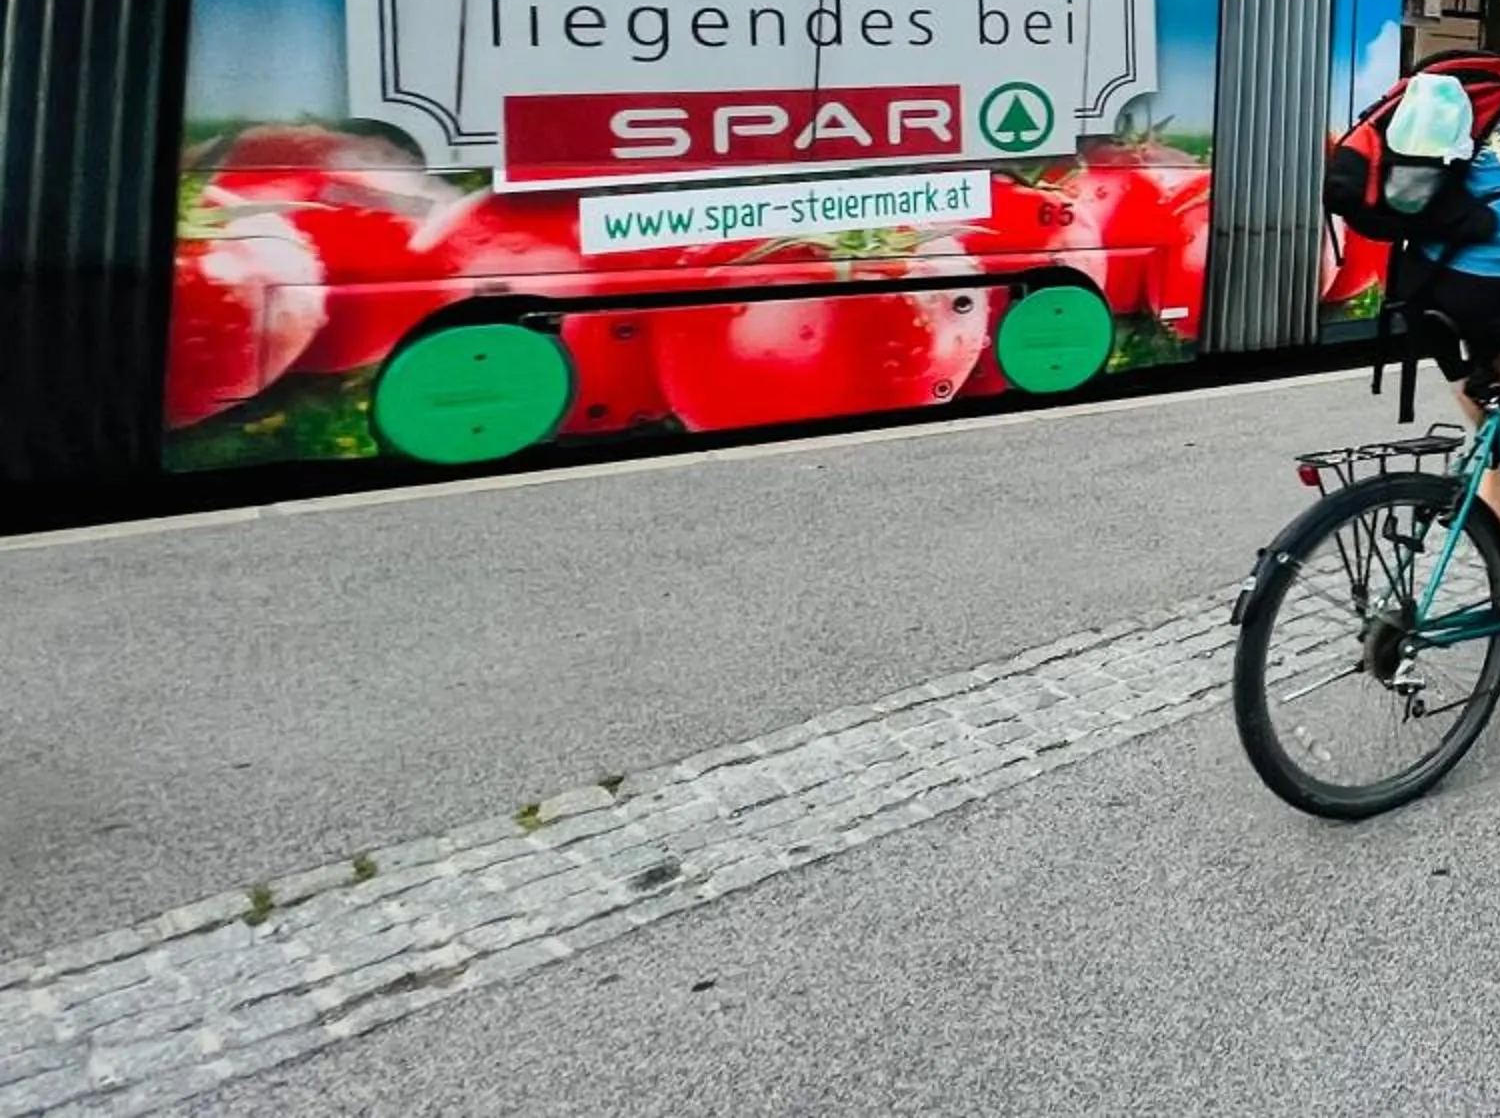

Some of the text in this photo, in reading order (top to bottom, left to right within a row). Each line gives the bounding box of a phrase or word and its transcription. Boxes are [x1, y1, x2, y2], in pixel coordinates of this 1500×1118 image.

[609, 99, 953, 160] SPAR
[603, 179, 972, 240] www.spar-steiermark.at
[1037, 200, 1075, 227] 65
